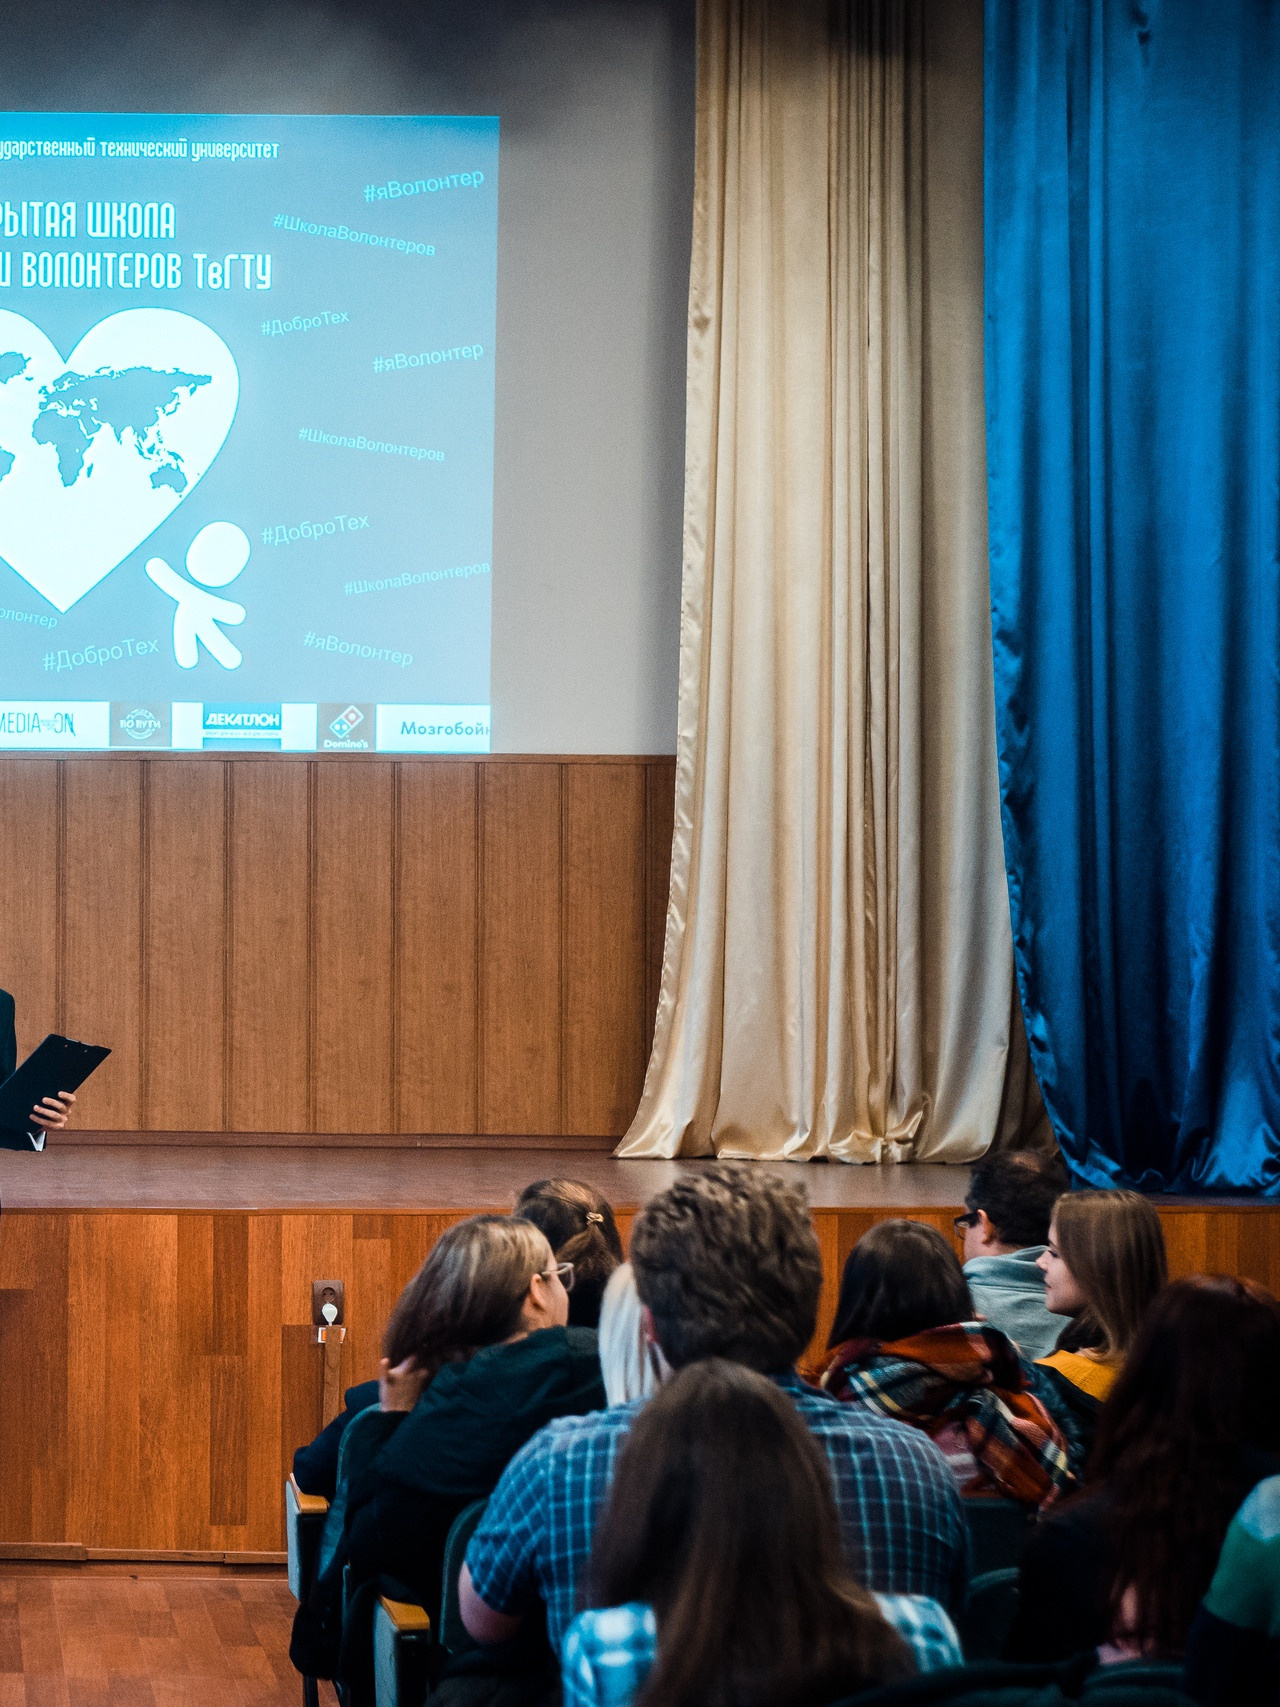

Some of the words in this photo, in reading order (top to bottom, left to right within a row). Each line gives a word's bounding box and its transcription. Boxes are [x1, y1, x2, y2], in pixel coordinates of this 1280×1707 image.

[100, 138, 188, 159] технический
[191, 141, 280, 162] университет
[363, 169, 485, 202] #яВолонтер
[86, 201, 176, 239] ШКОЛА
[273, 213, 436, 256] #ШколаВолонтеров
[22, 251, 182, 289] ВОЛОНТЕРОВ
[193, 252, 272, 290] ТвГТУ
[261, 310, 350, 337] #ДоброТех
[372, 342, 484, 373] #яВолонтер
[298, 427, 446, 462] #ШколаВолонтеров
[261, 514, 371, 546] #ДоброТех
[343, 561, 491, 596] #ШколаВолонтеров
[42, 638, 159, 672] #ДоброТех
[303, 631, 414, 668] #яВолонтер
[205, 713, 280, 726] ДЕКАТЛОН
[323, 739, 368, 749] Domino's
